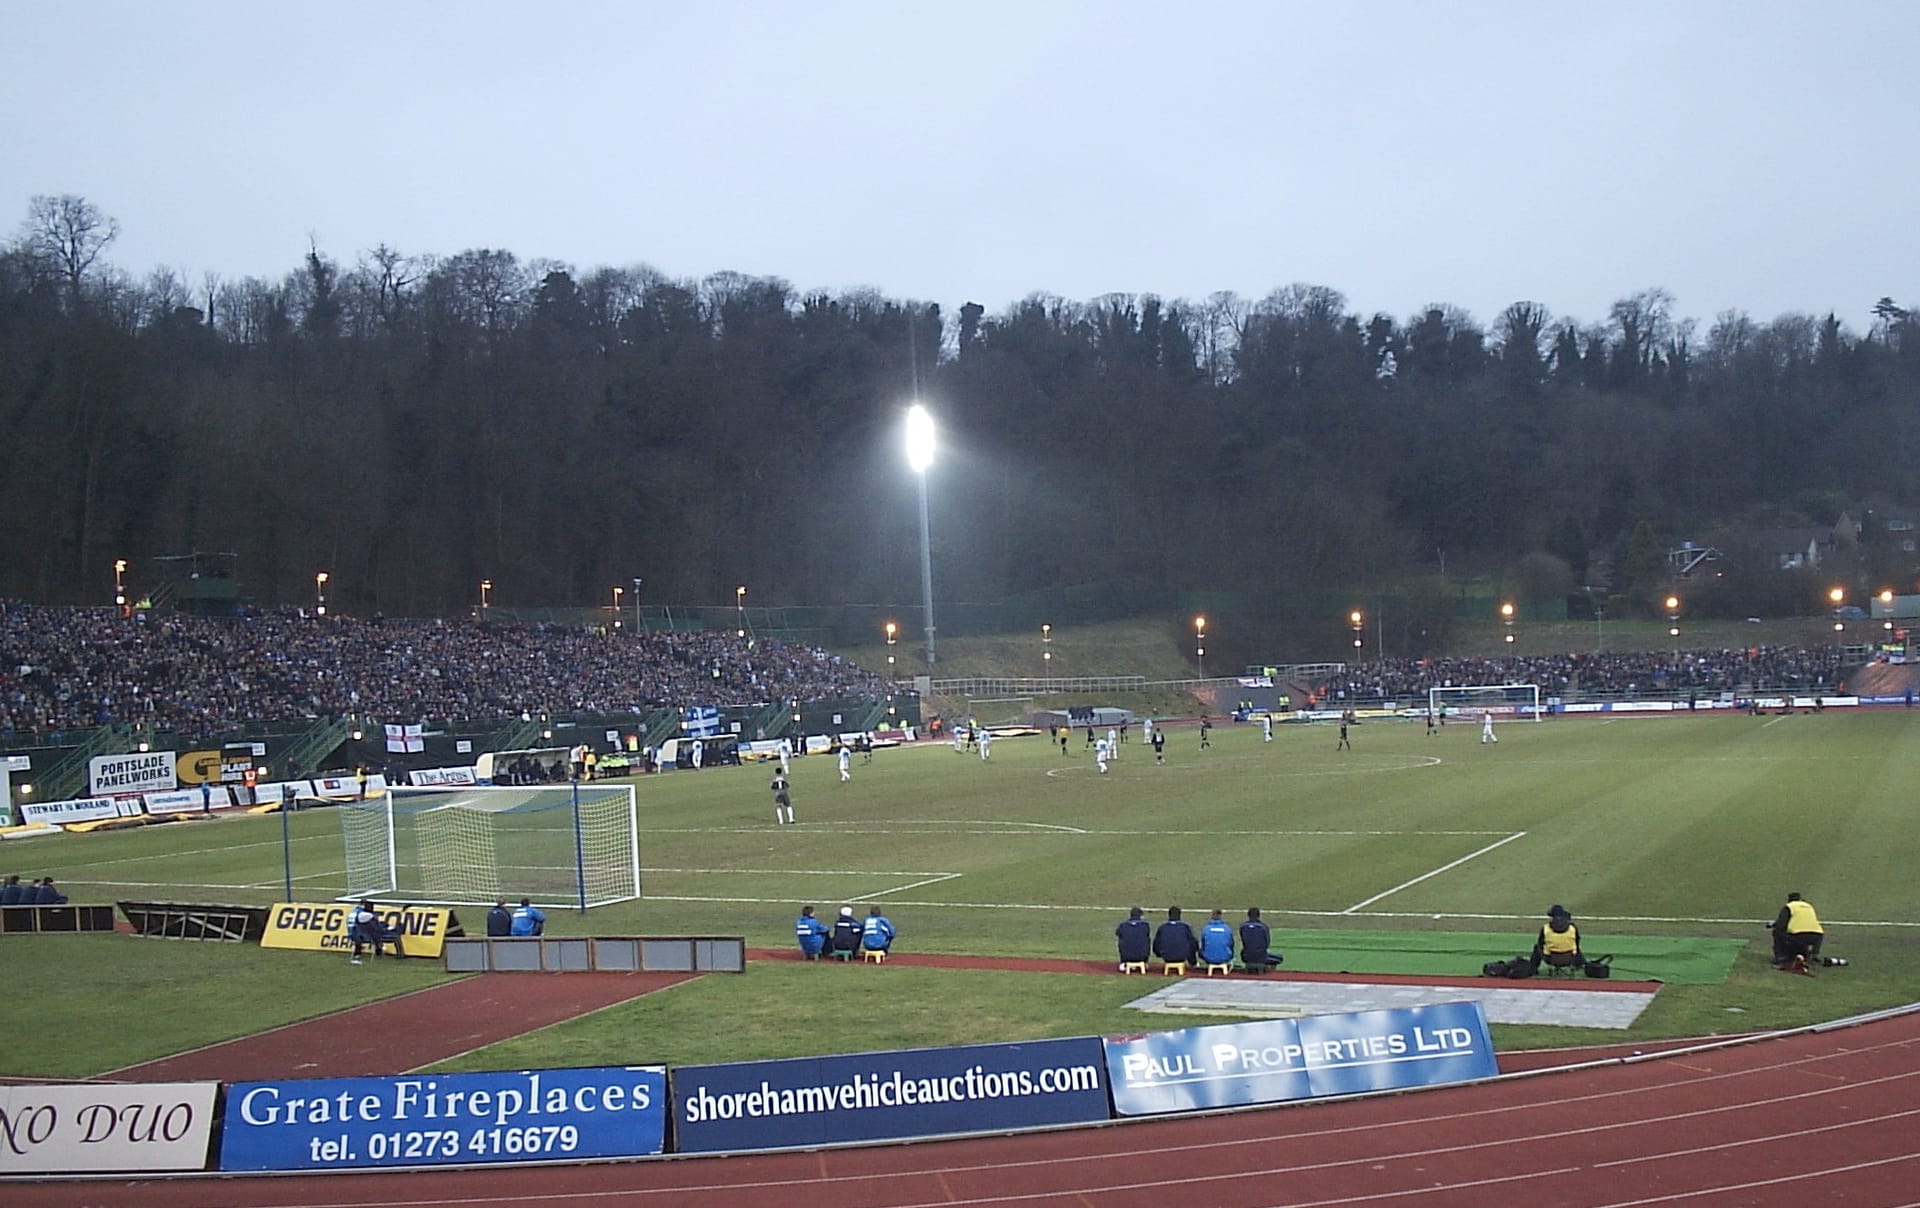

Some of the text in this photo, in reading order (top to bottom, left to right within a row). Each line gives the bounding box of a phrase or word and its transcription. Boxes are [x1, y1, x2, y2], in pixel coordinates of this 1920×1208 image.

[96, 767, 170, 788] PANELWORKS
[101, 755, 165, 775] PORTSLADE
[416, 770, 468, 784] The Argus
[276, 907, 344, 931] GREG
[1123, 1026, 1473, 1081] PAUL PROPERTIES LTD
[240, 1074, 651, 1126] Grate Fireplaces
[685, 1064, 1100, 1122] shorehamvehicleauctions.com
[77, 1103, 193, 1143] DUO
[309, 1125, 578, 1162] tel. 01273 416679
